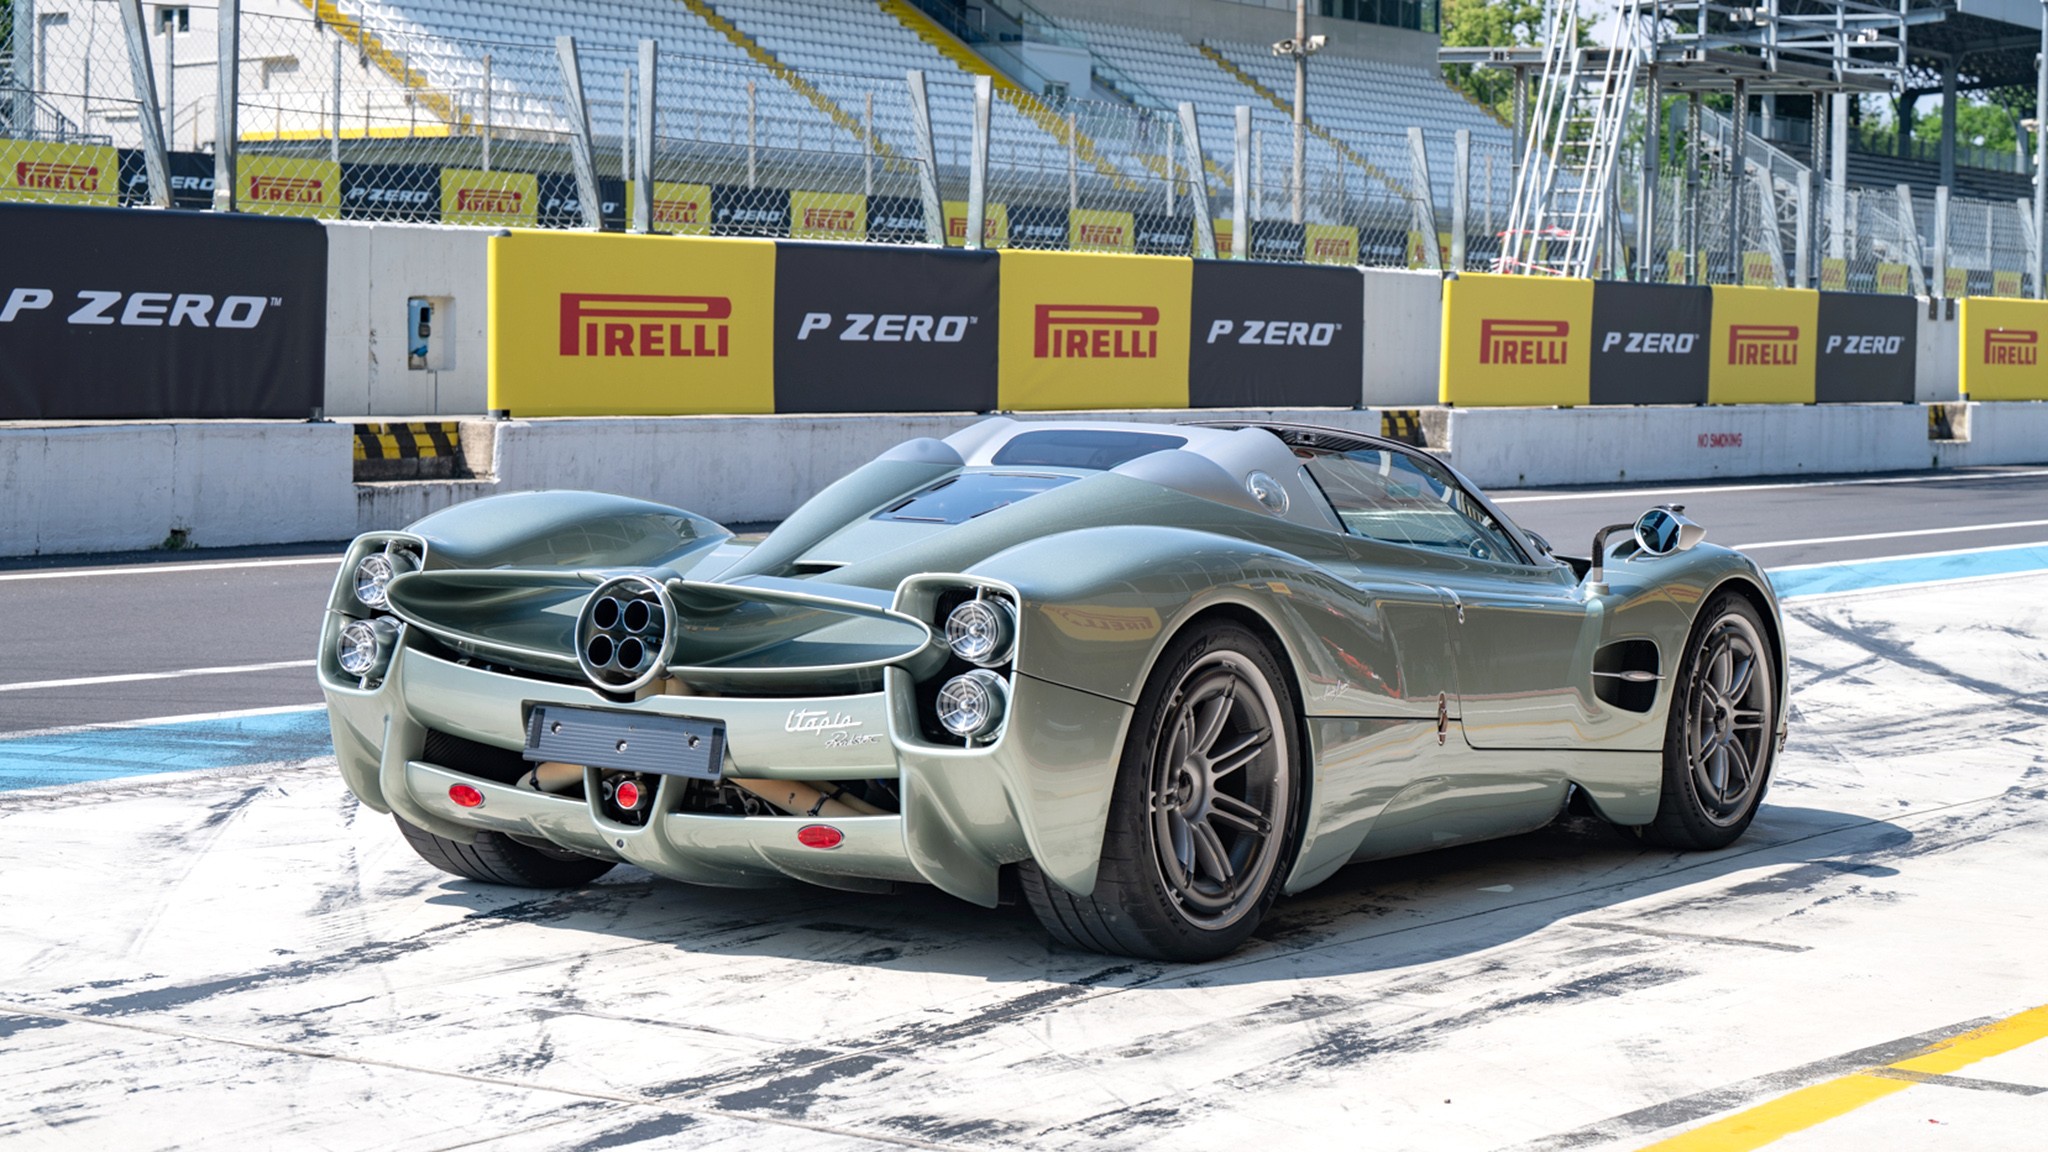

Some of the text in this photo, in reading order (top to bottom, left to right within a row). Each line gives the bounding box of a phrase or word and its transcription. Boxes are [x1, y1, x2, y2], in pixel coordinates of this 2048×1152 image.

[17, 162, 98, 191] PIRELLI
[129, 175, 215, 191] P ERO
[251, 176, 322, 203] PIRELLI
[350, 187, 365, 199] P
[457, 188, 522, 213] PIRELLI
[546, 199, 560, 210] P
[718, 209, 731, 219] P
[804, 208, 855, 230] PIRELLI
[873, 217, 885, 227] P
[0, 288, 53, 322] P
[560, 293, 732, 357] PIRELLI
[797, 313, 831, 340] P
[1034, 304, 1160, 358] PIRELLI
[1207, 320, 1234, 344] P
[1479, 319, 1570, 365] PIRELLI
[1602, 332, 1621, 352] P
[1727, 325, 1799, 365] PIRELLI
[1826, 335, 1842, 354] P
[1984, 329, 2038, 365] PIRELLI
[1697, 432, 1708, 448] NO
